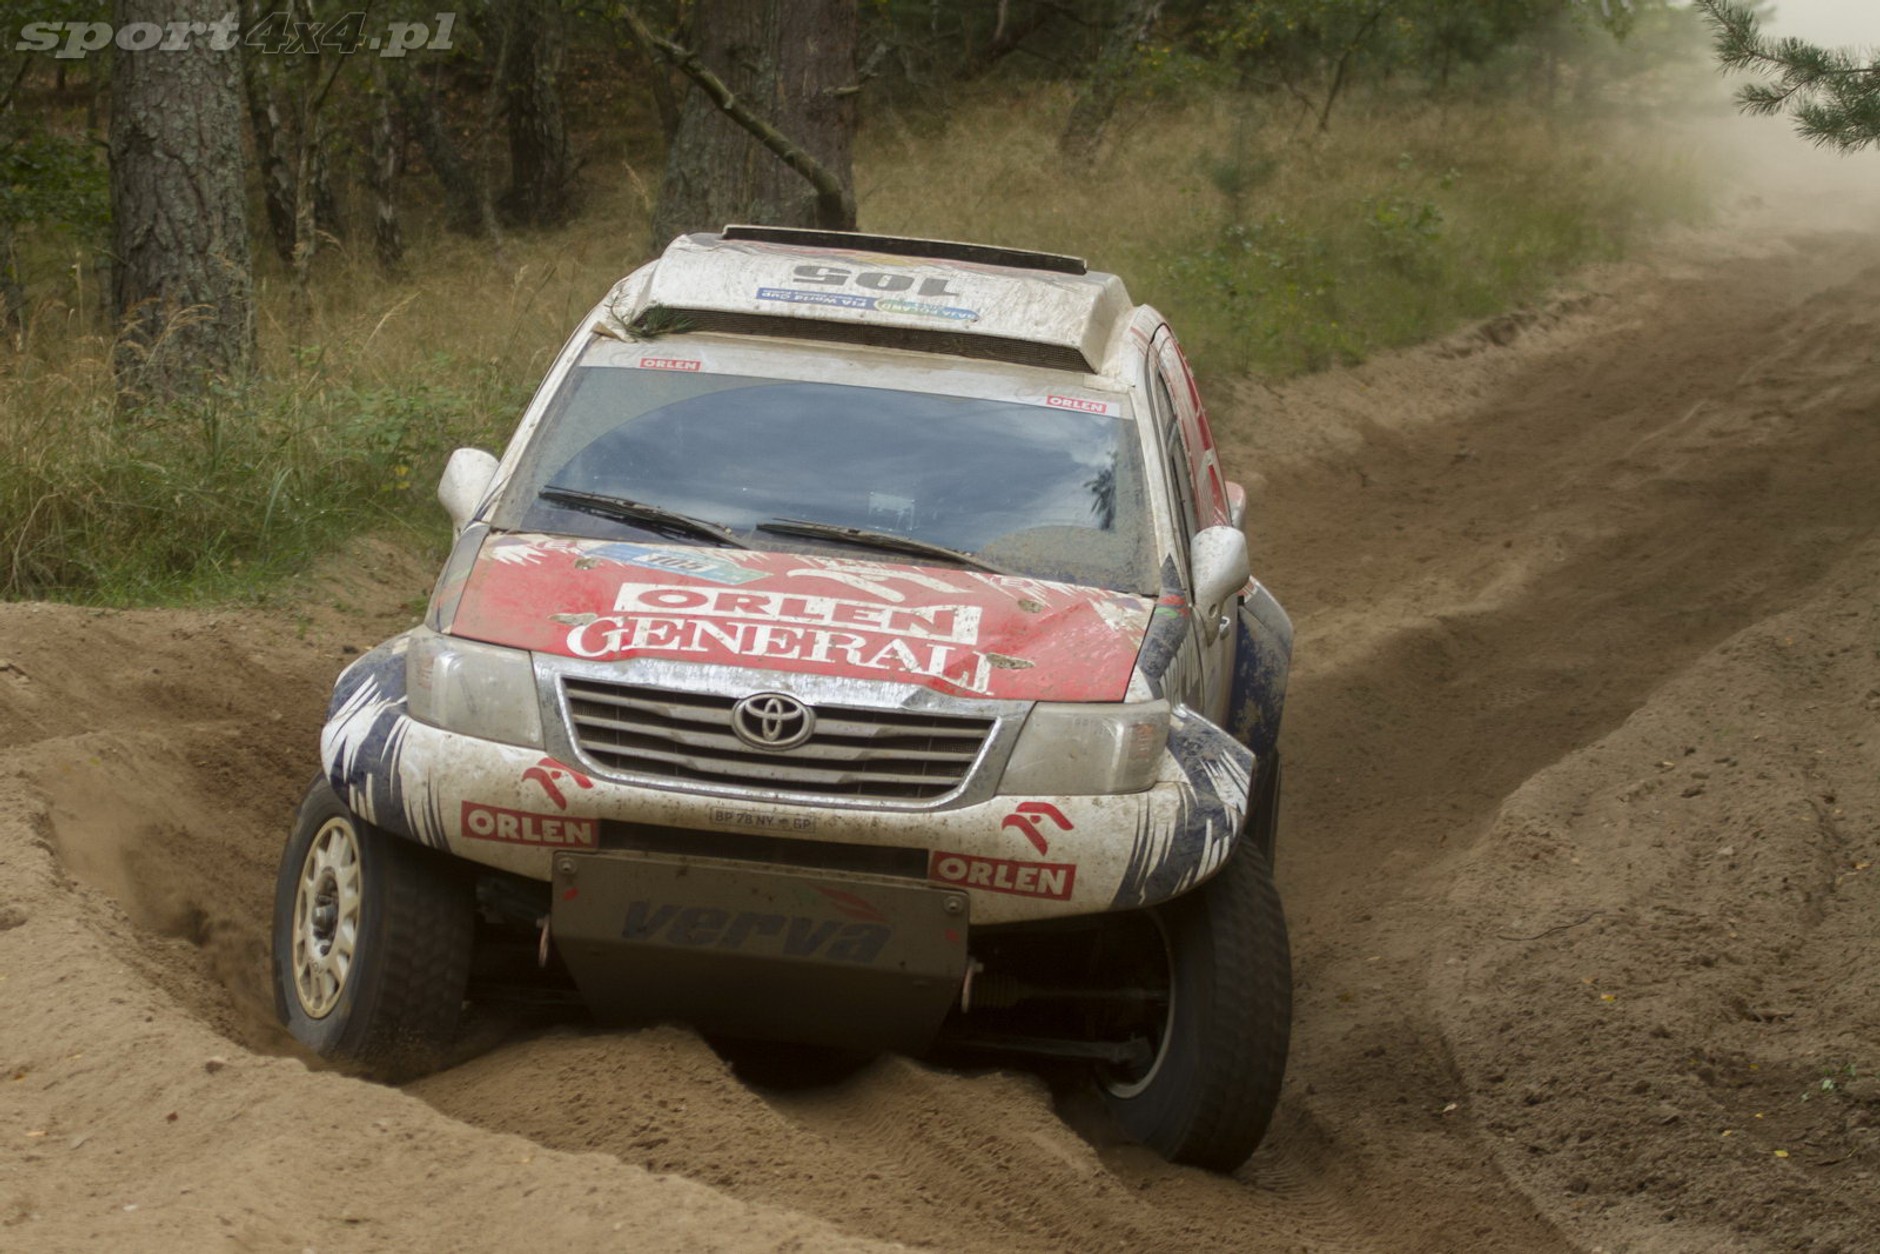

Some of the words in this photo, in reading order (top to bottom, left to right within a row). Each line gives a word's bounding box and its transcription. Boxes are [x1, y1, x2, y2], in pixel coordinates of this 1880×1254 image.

[793, 265, 959, 297] 105
[761, 292, 791, 300] Cup
[794, 294, 837, 304] World
[841, 299, 867, 307] FIA
[643, 358, 697, 371] ORLEN
[1048, 397, 1103, 413] ORLEN
[636, 587, 957, 641] ORLEN
[566, 616, 995, 696] GENERALI
[466, 808, 593, 845] ORLEN
[715, 810, 733, 823] BP
[755, 815, 775, 827] NY
[936, 856, 1067, 896] ORLEN
[620, 900, 894, 962] verva
